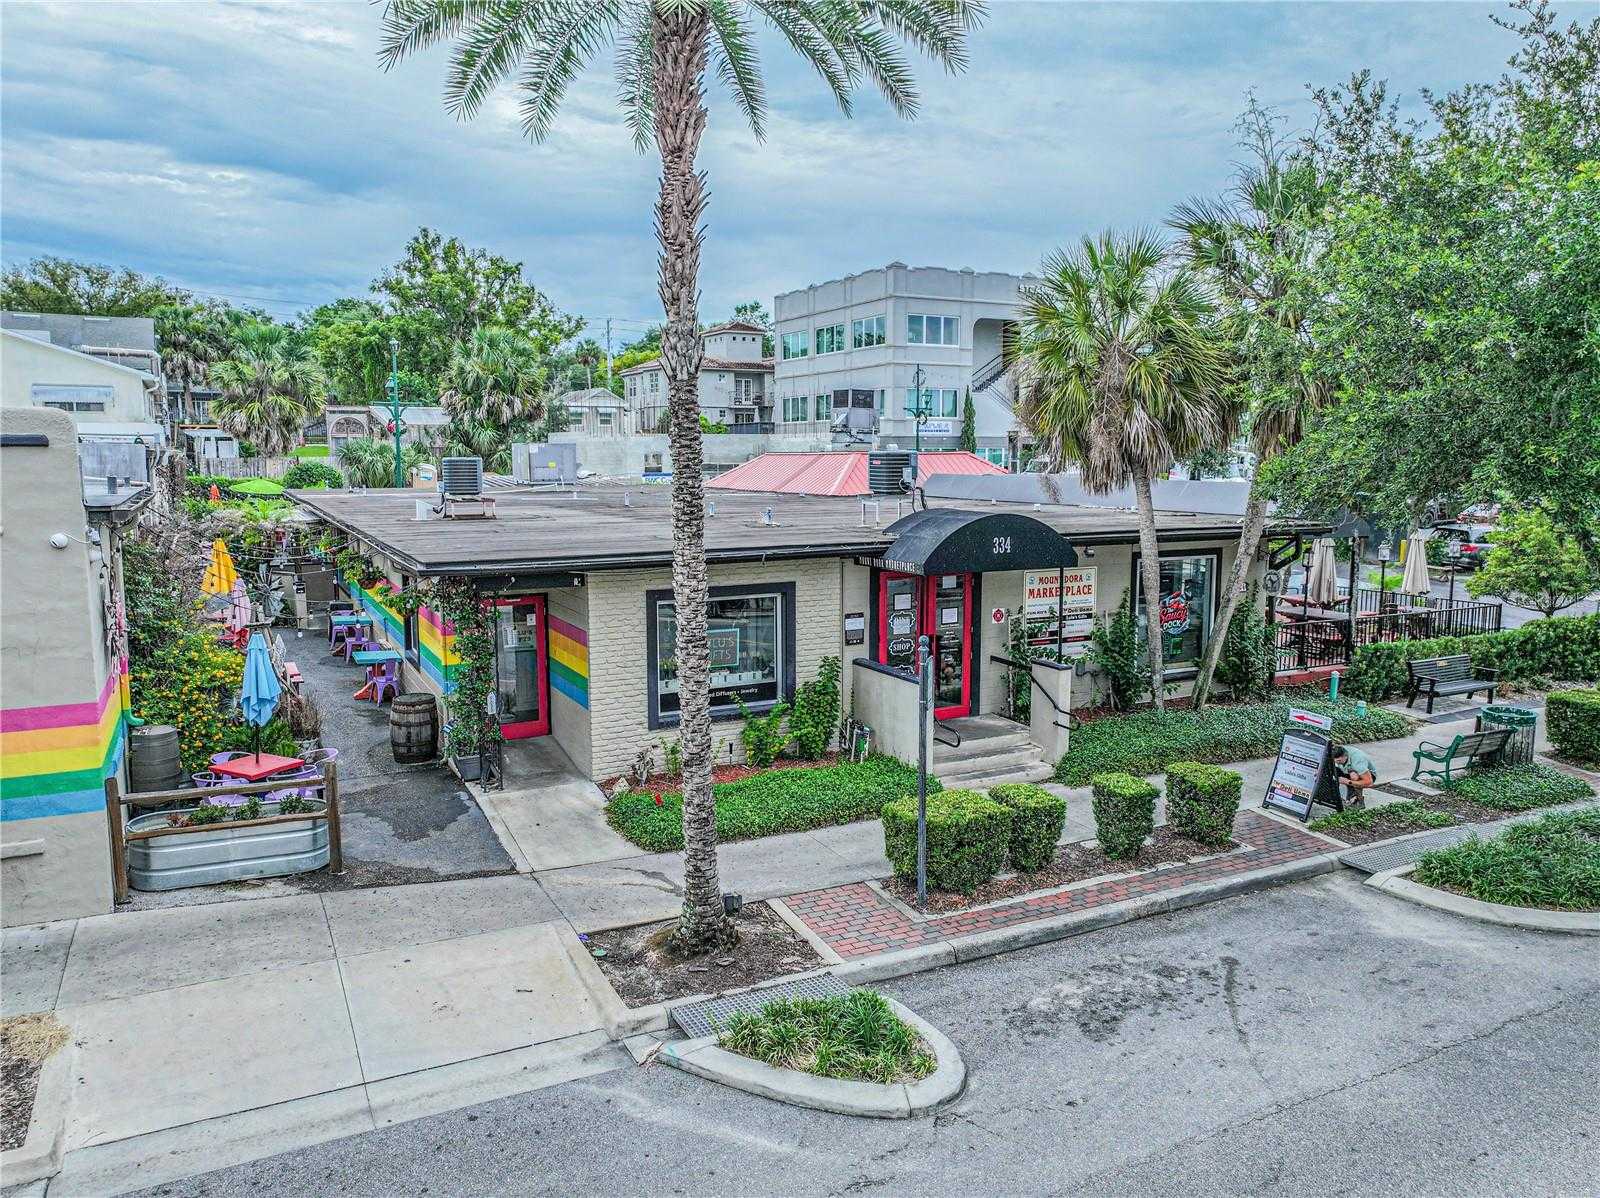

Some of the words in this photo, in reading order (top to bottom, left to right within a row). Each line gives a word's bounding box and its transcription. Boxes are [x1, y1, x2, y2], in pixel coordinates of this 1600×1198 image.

[993, 536, 1011, 554] 334
[1038, 575, 1061, 586] MOUN
[1064, 574, 1083, 584] DORA
[1028, 584, 1093, 599] MARKEPLACE
[892, 642, 911, 651] SHOP
